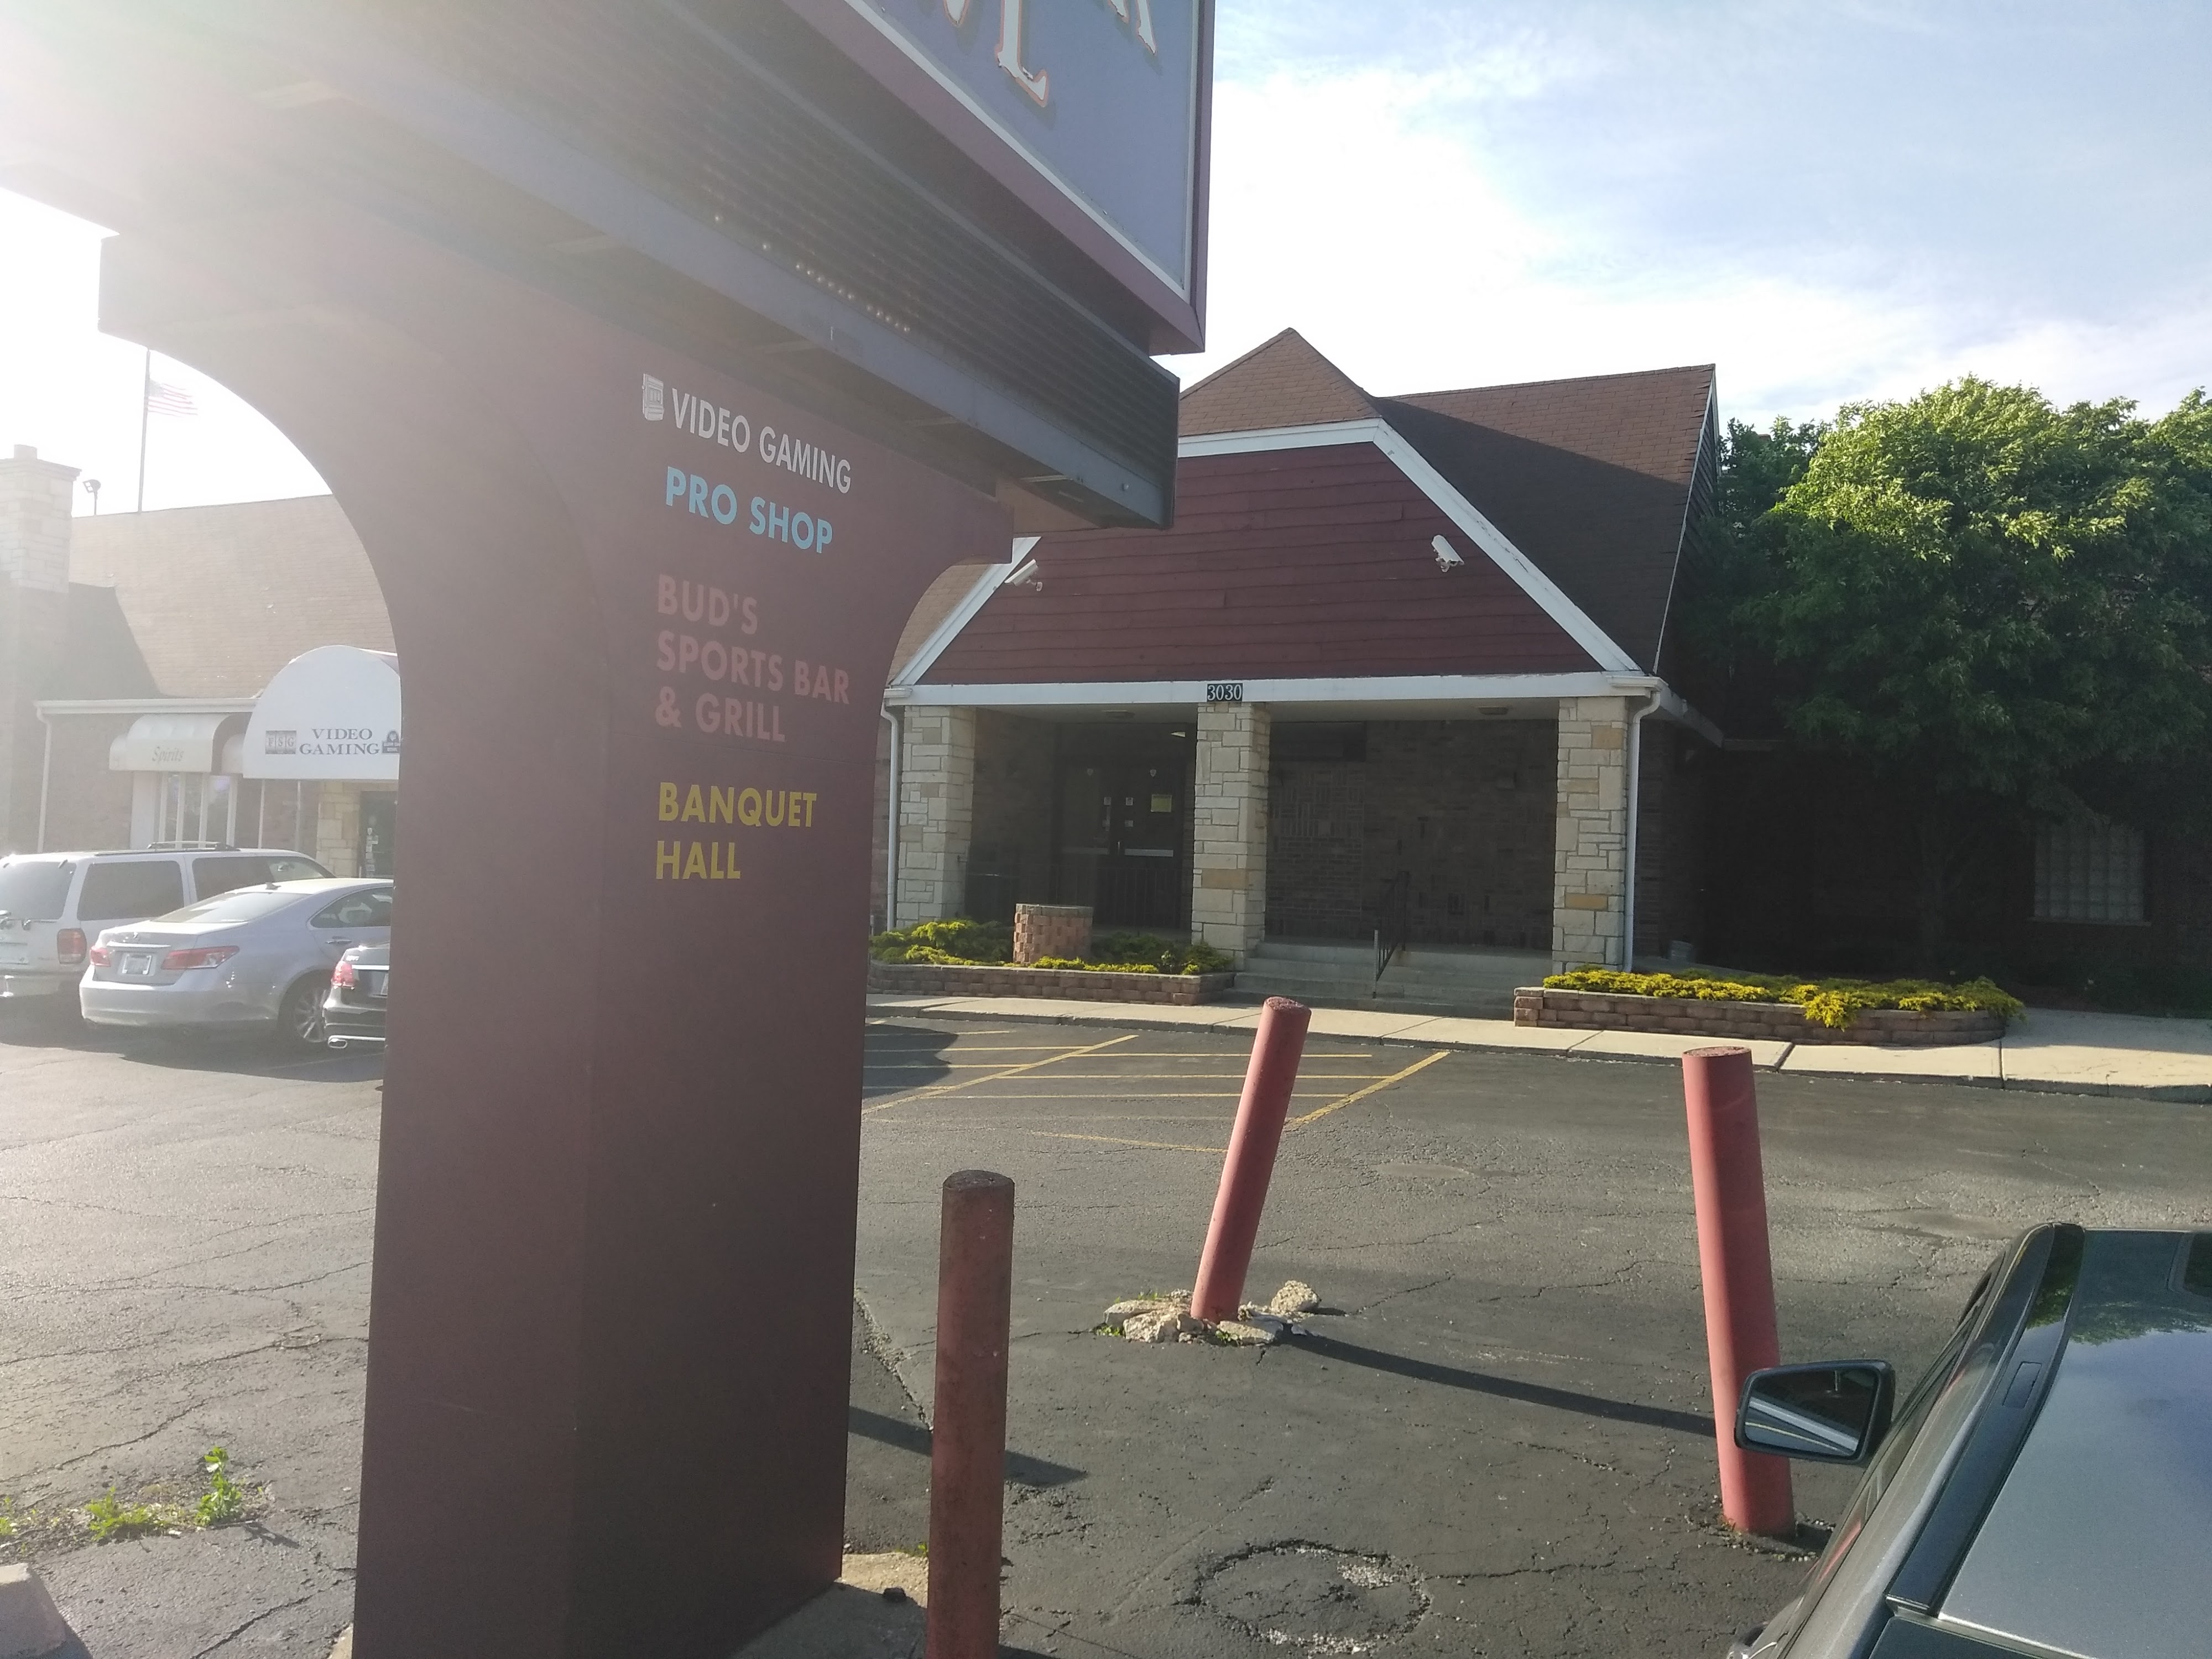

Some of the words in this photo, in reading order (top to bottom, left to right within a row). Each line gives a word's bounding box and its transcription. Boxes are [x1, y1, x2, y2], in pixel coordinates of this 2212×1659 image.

[672, 388, 750, 452] VIDEO
[759, 426, 852, 493] GAMING
[666, 466, 737, 525] PRO
[749, 497, 833, 554] SHOP
[658, 573, 758, 635] BUD'S
[656, 630, 784, 691] SPORTS
[794, 660, 850, 705] BAR
[655, 686, 681, 728] &
[696, 692, 786, 742] GRILL
[1207, 684, 1242, 701] 3030
[152, 746, 185, 764] Spirits
[299, 743, 380, 755] GAMING
[312, 728, 373, 740] VIDEO
[659, 782, 817, 827] BANQUET
[656, 841, 741, 879] HALL
